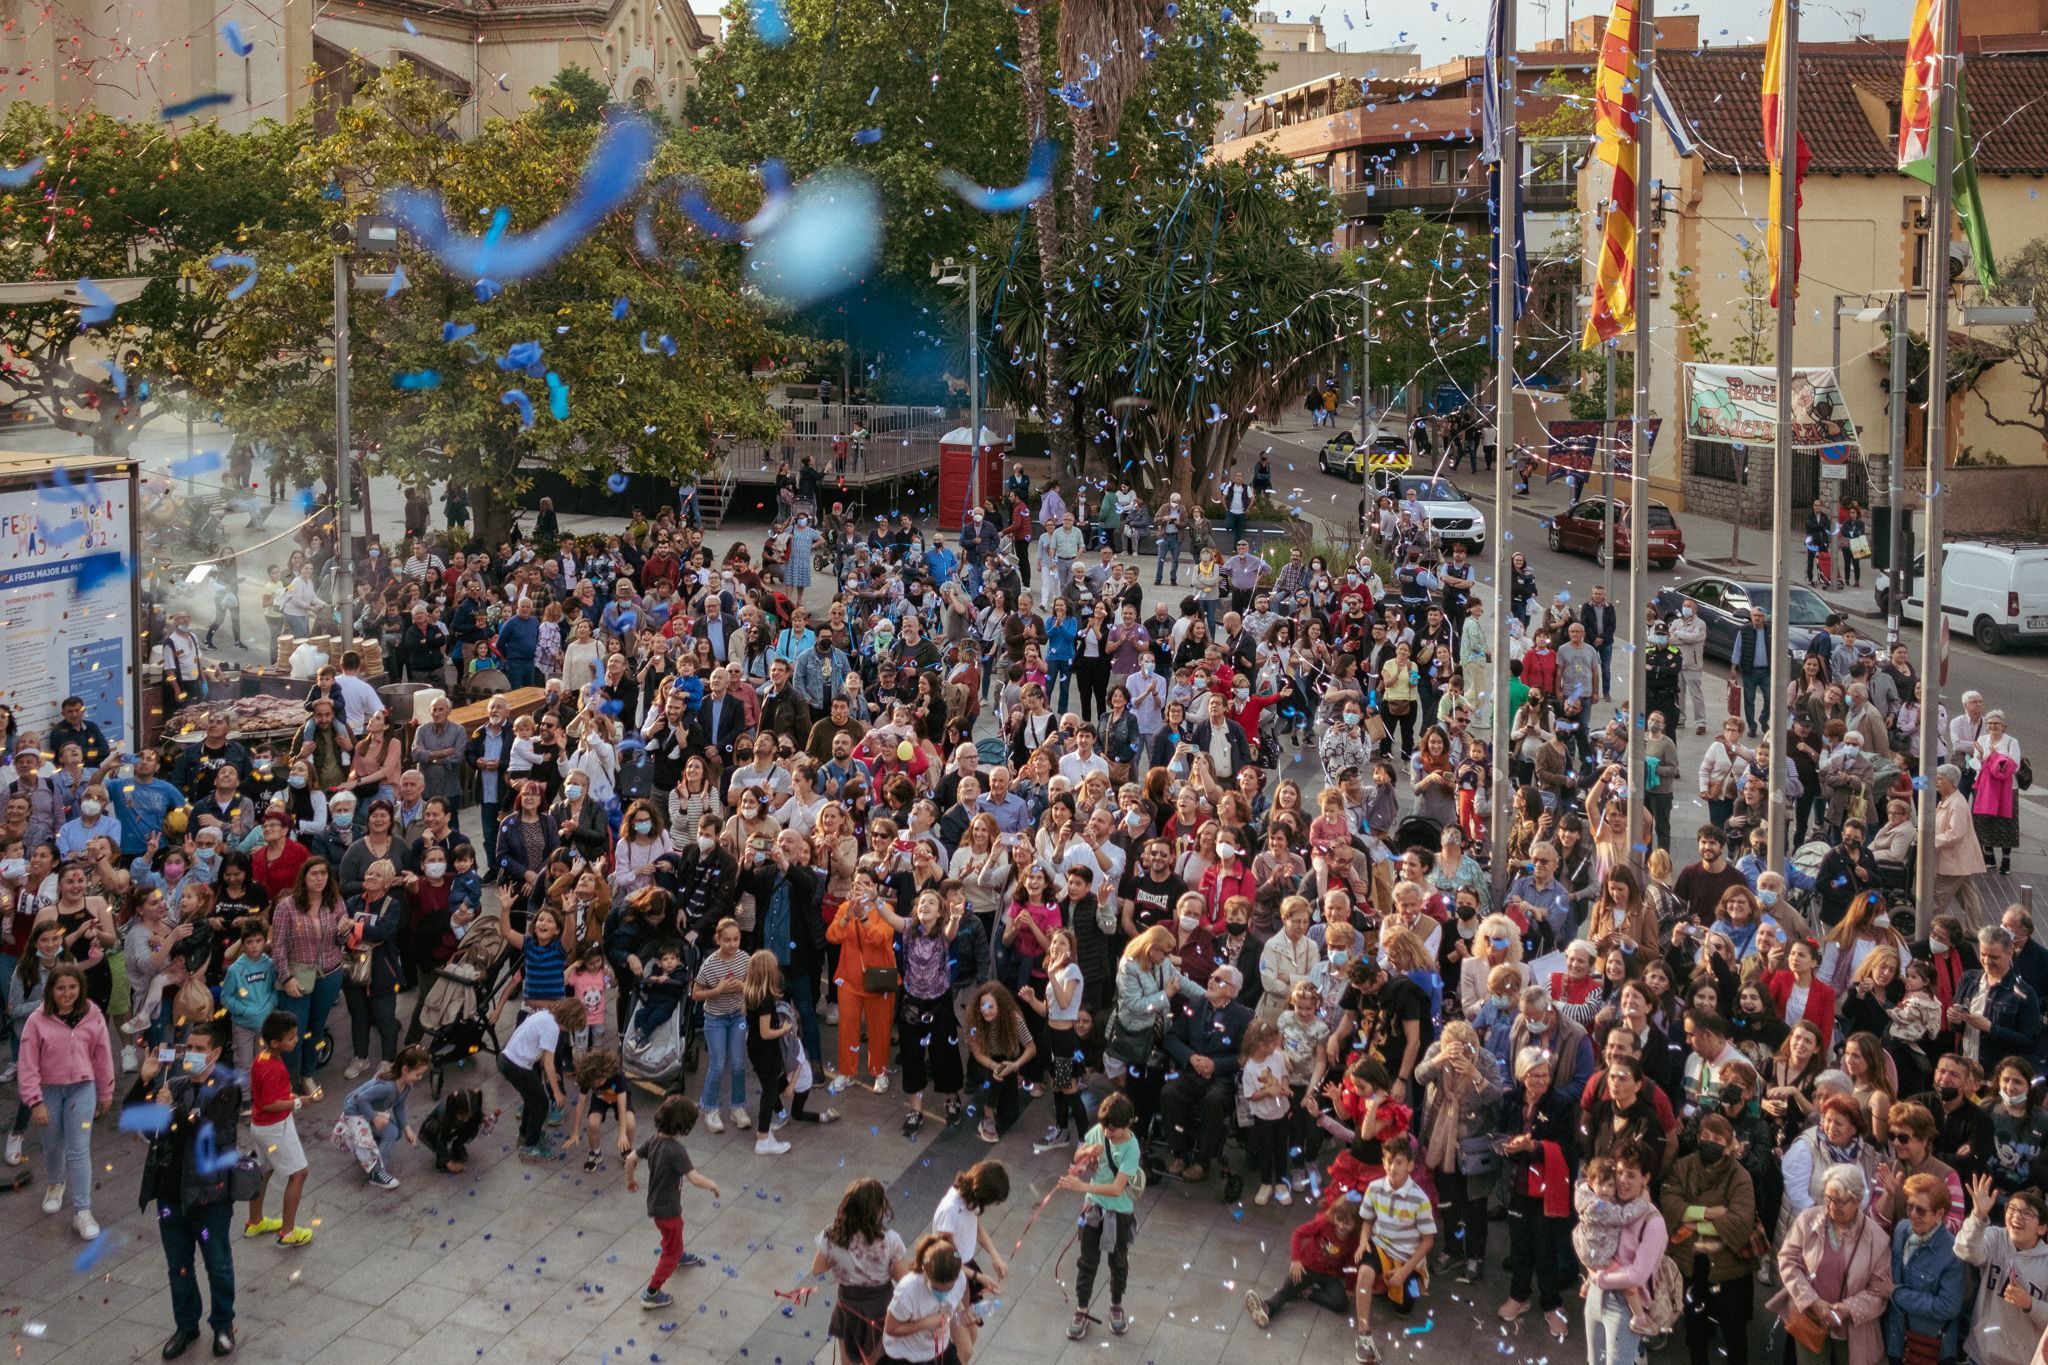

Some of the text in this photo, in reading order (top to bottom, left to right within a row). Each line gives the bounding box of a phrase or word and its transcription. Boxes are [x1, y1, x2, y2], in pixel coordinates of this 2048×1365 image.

[1726, 376, 1778, 403] Merca
[79, 531, 107, 549] 2022
[15, 570, 35, 582] FESTA
[36, 566, 60, 579] MAJOR
[61, 563, 69, 574] AL
